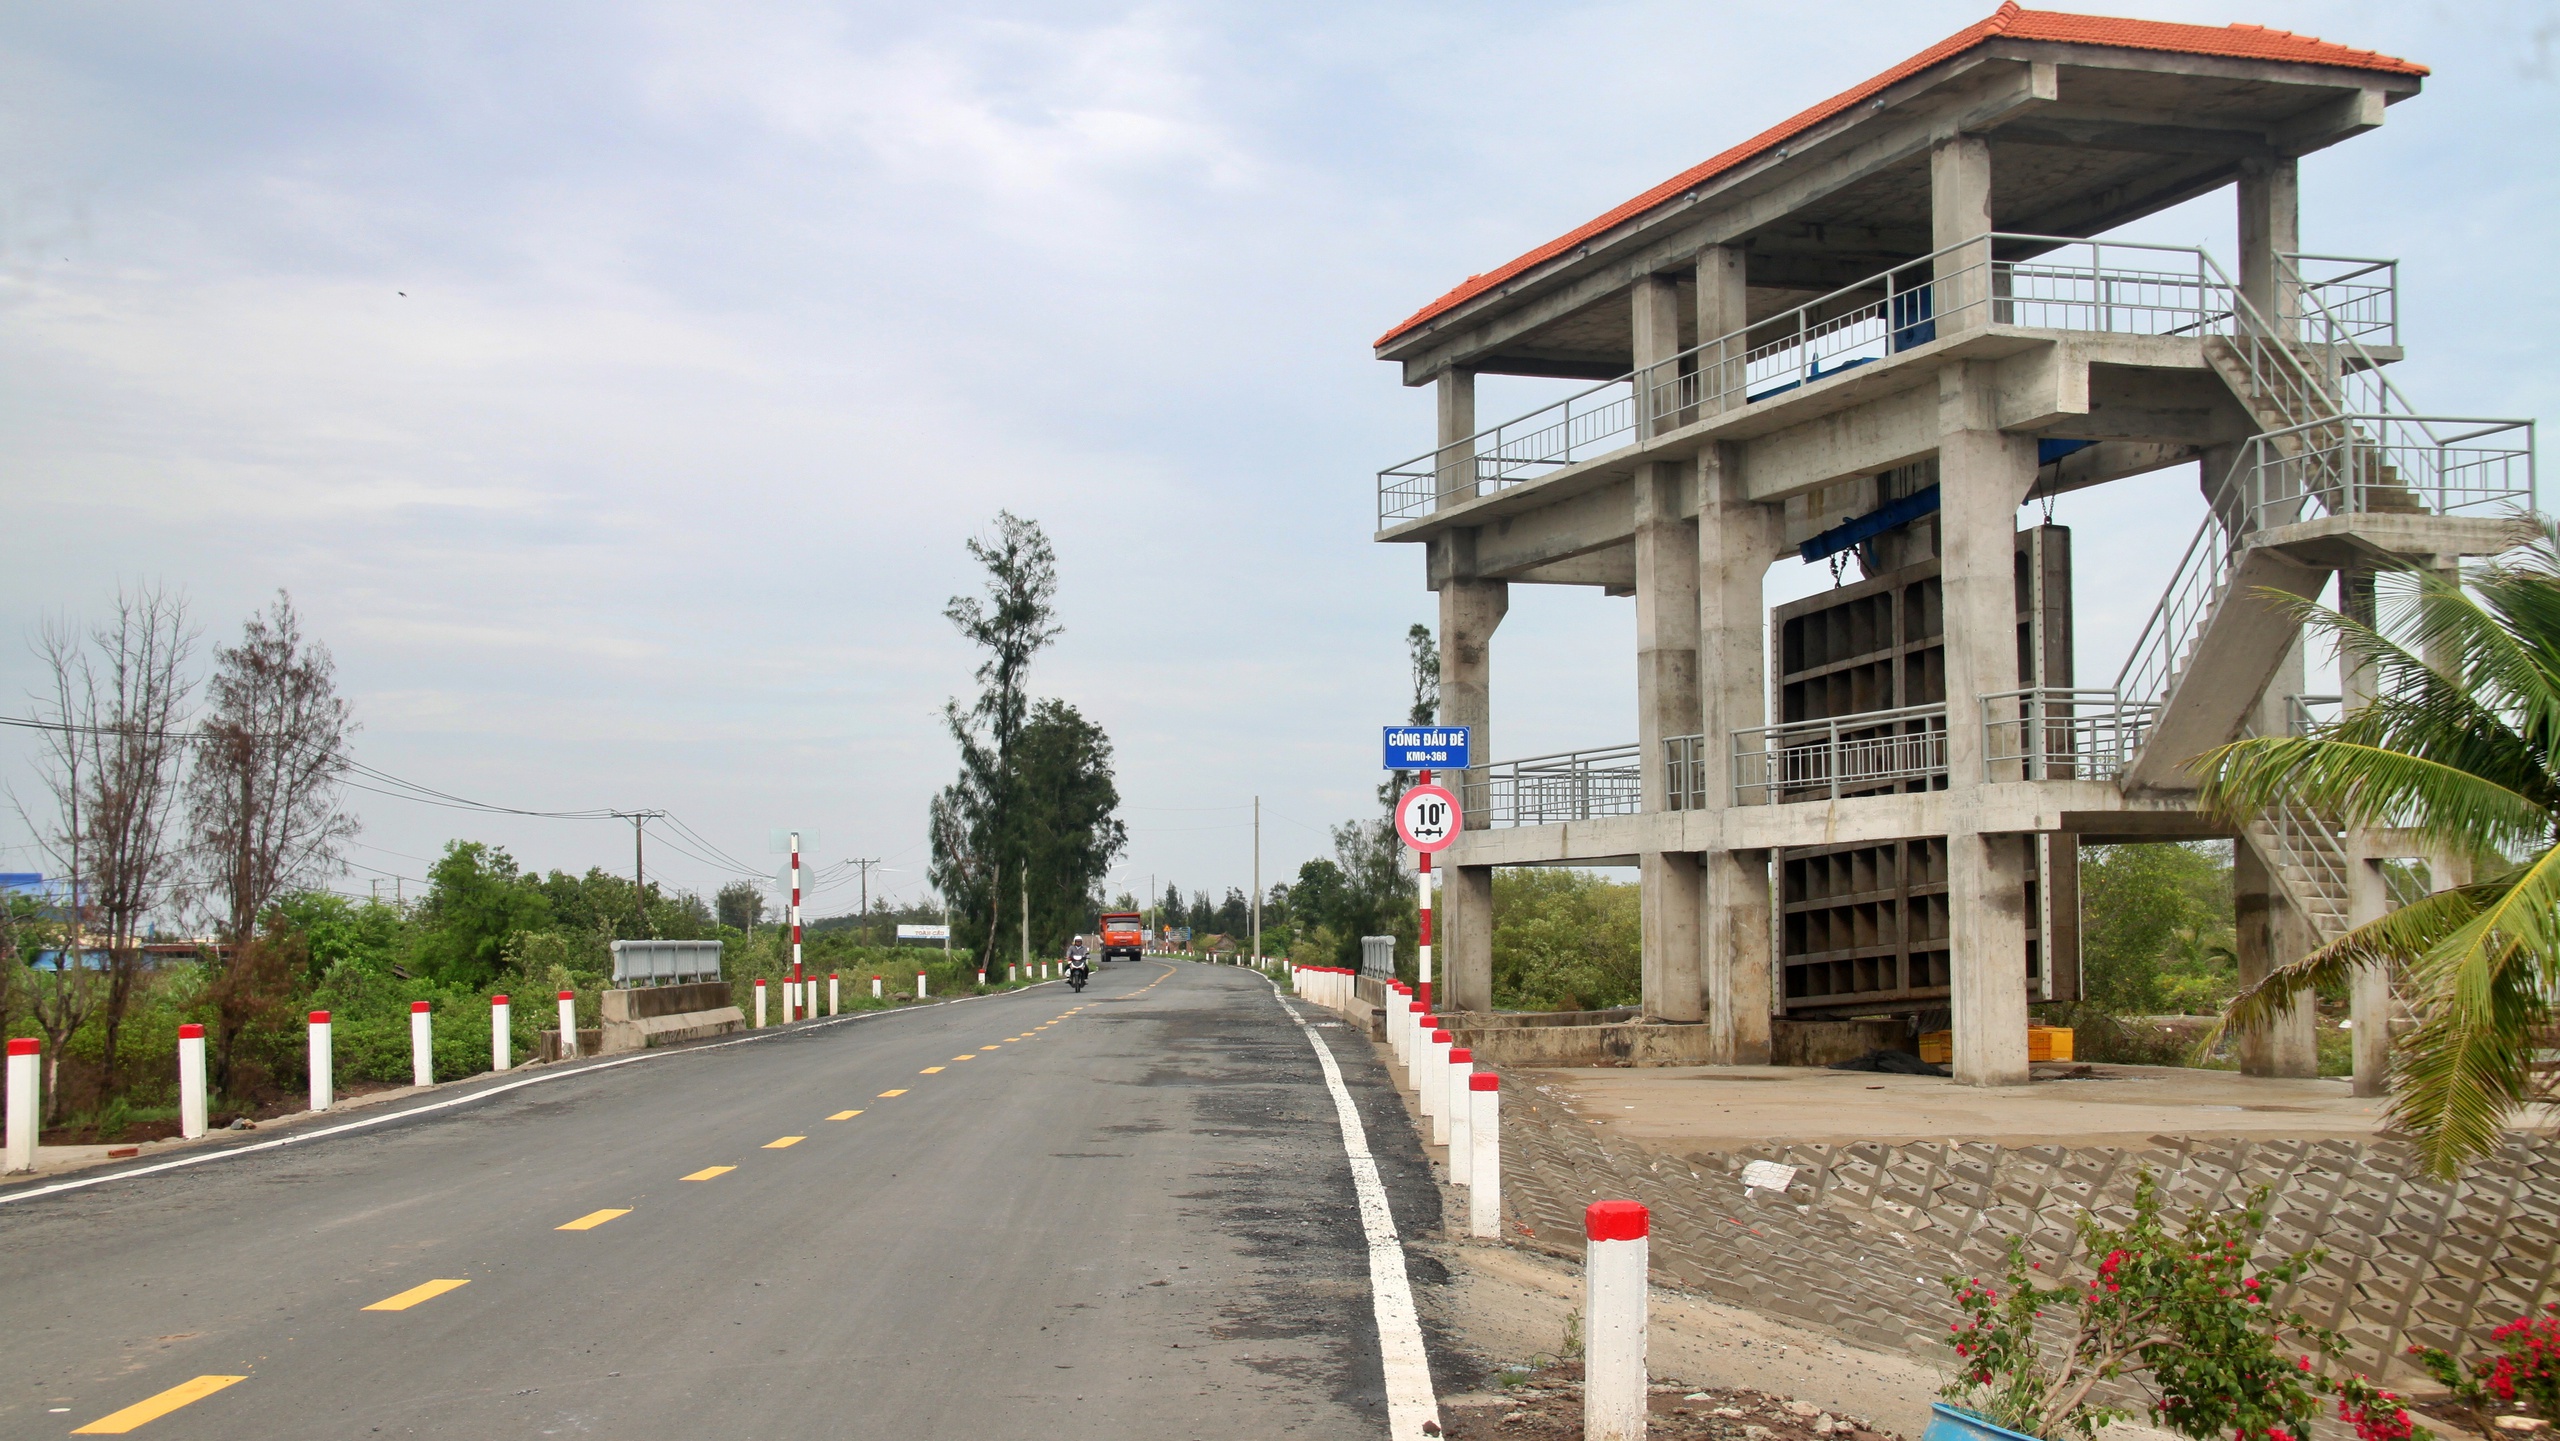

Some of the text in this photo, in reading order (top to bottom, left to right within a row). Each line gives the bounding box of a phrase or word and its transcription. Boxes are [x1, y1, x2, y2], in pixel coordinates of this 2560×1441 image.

[1389, 729, 1464, 746] CỐNG ĐẦU ĐÊ
